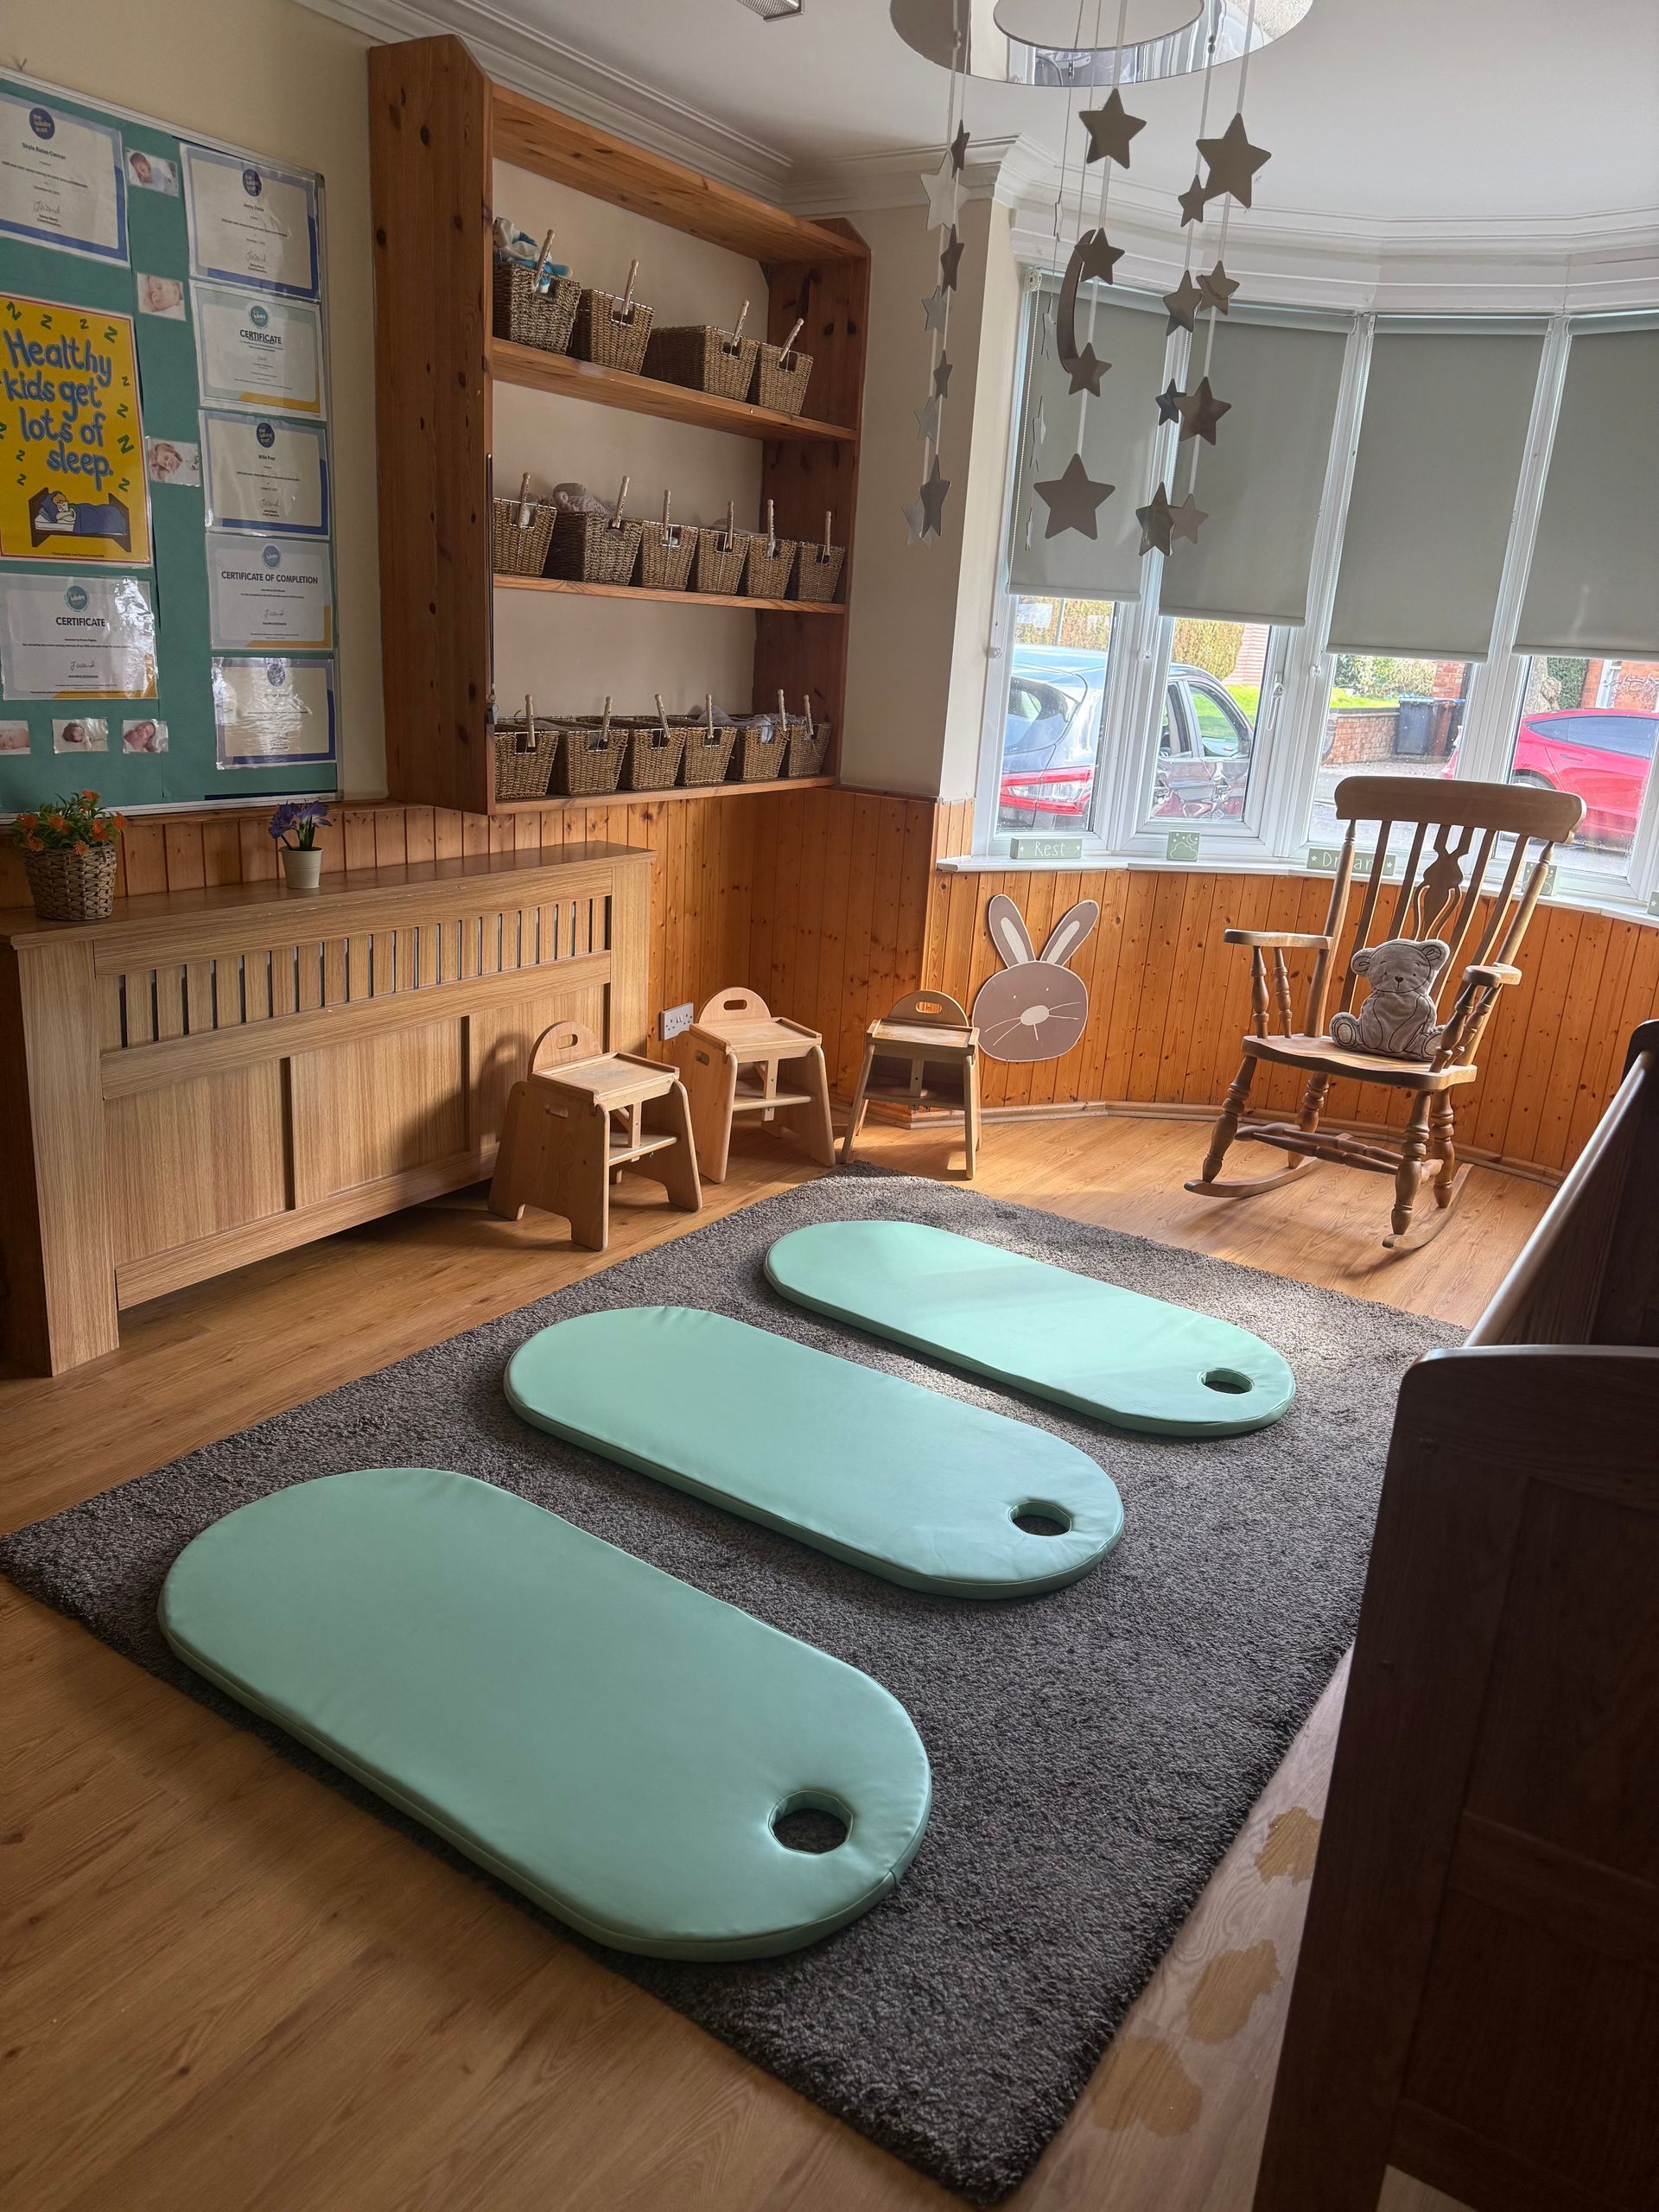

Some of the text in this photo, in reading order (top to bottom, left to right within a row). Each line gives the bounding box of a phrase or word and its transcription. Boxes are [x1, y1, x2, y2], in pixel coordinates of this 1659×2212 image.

[239, 329, 283, 345] CERTIFICATE
[3, 327, 112, 387] Healthy
[3, 369, 103, 422] kids get
[19, 406, 106, 447] lots of
[47, 442, 114, 492] sleep.
[221, 570, 264, 582] CERTIFICATE
[276, 574, 318, 584] COMPLETION
[55, 616, 106, 627] CERTIFICATE
[1034, 841, 1065, 857] Rest
[1322, 851, 1375, 871] Dra
